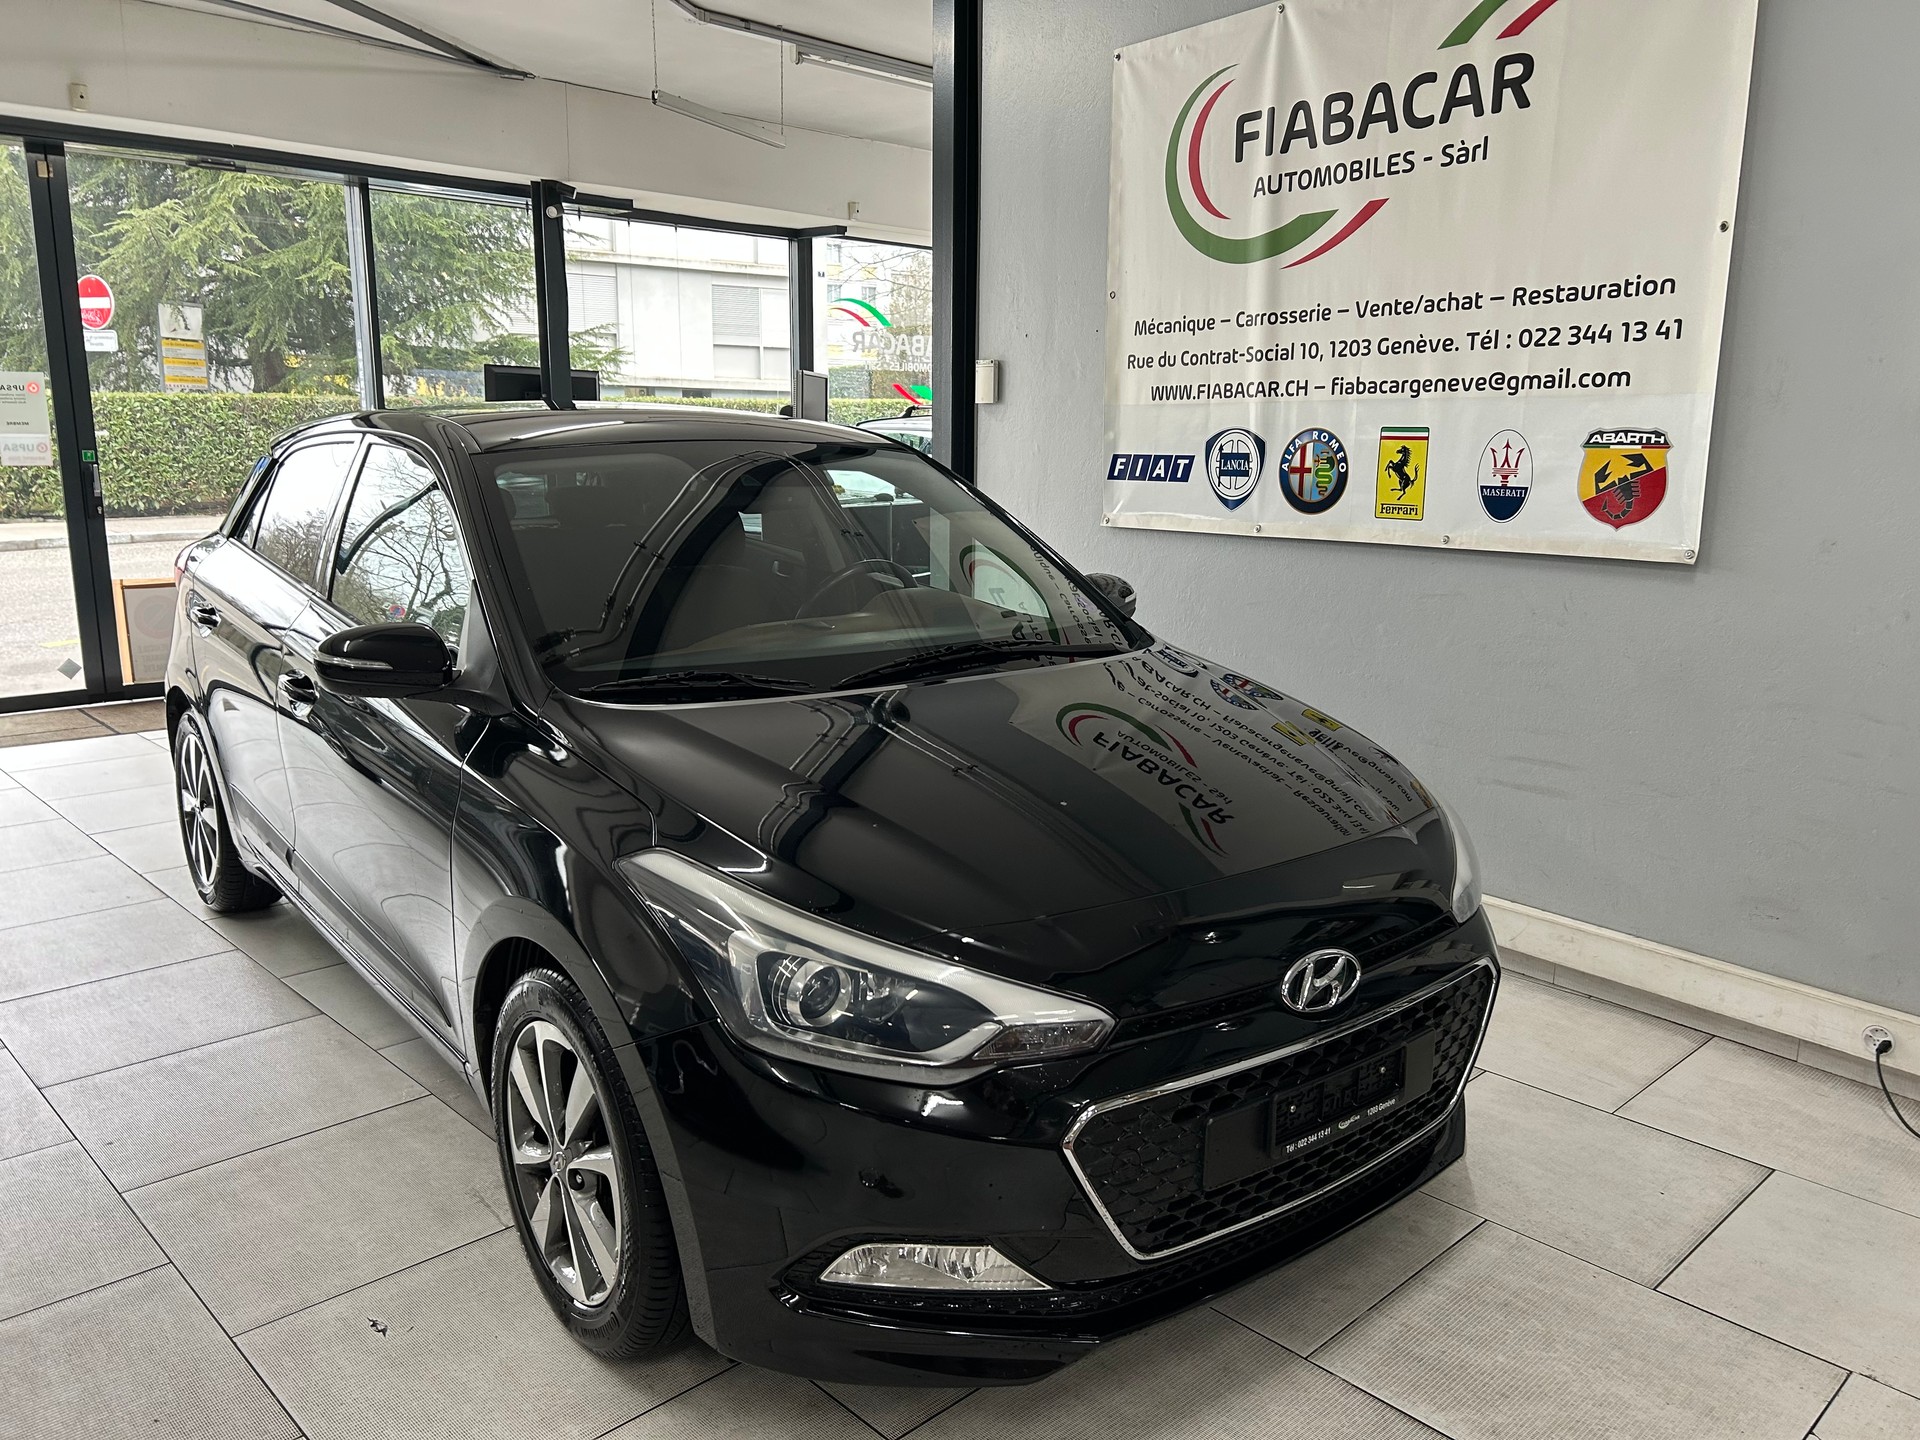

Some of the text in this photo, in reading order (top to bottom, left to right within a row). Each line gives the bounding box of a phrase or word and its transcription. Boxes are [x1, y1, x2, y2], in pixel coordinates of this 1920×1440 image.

[1234, 52, 1535, 163] FIABACAR
[1253, 150, 1415, 198] AUTOMOBILES
[1440, 135, 1489, 167] Sàrl
[1134, 317, 1216, 337] Mécanique
[1235, 303, 1332, 328] Carrosserie
[1355, 291, 1484, 319] Vente/achat
[1512, 274, 1676, 306] Restauration
[1127, 354, 1154, 370] Rue
[1158, 351, 1177, 368] du
[1180, 342, 1295, 366] Contrat-Social
[1300, 341, 1324, 362] 10,
[1329, 339, 1372, 358] 1203
[1377, 333, 1459, 356] Genève.
[1467, 329, 1500, 351] Tél
[1518, 326, 1561, 348] 022
[1567, 323, 1612, 346] 344
[1621, 321, 1648, 343] 13
[1655, 318, 1683, 340] 41
[1151, 379, 1309, 401] WWW.FIABACAR.CH
[1331, 367, 1631, 398] fiabacargeneve@gmail.com
[1281, 430, 1347, 473] ALFA ROMEO
[1588, 431, 1666, 445] ABARTH
[1112, 457, 1190, 478] FIAT
[1221, 458, 1250, 472] LANCIA
[1379, 502, 1419, 516] Ferrari
[1482, 487, 1526, 498] MASERATI
